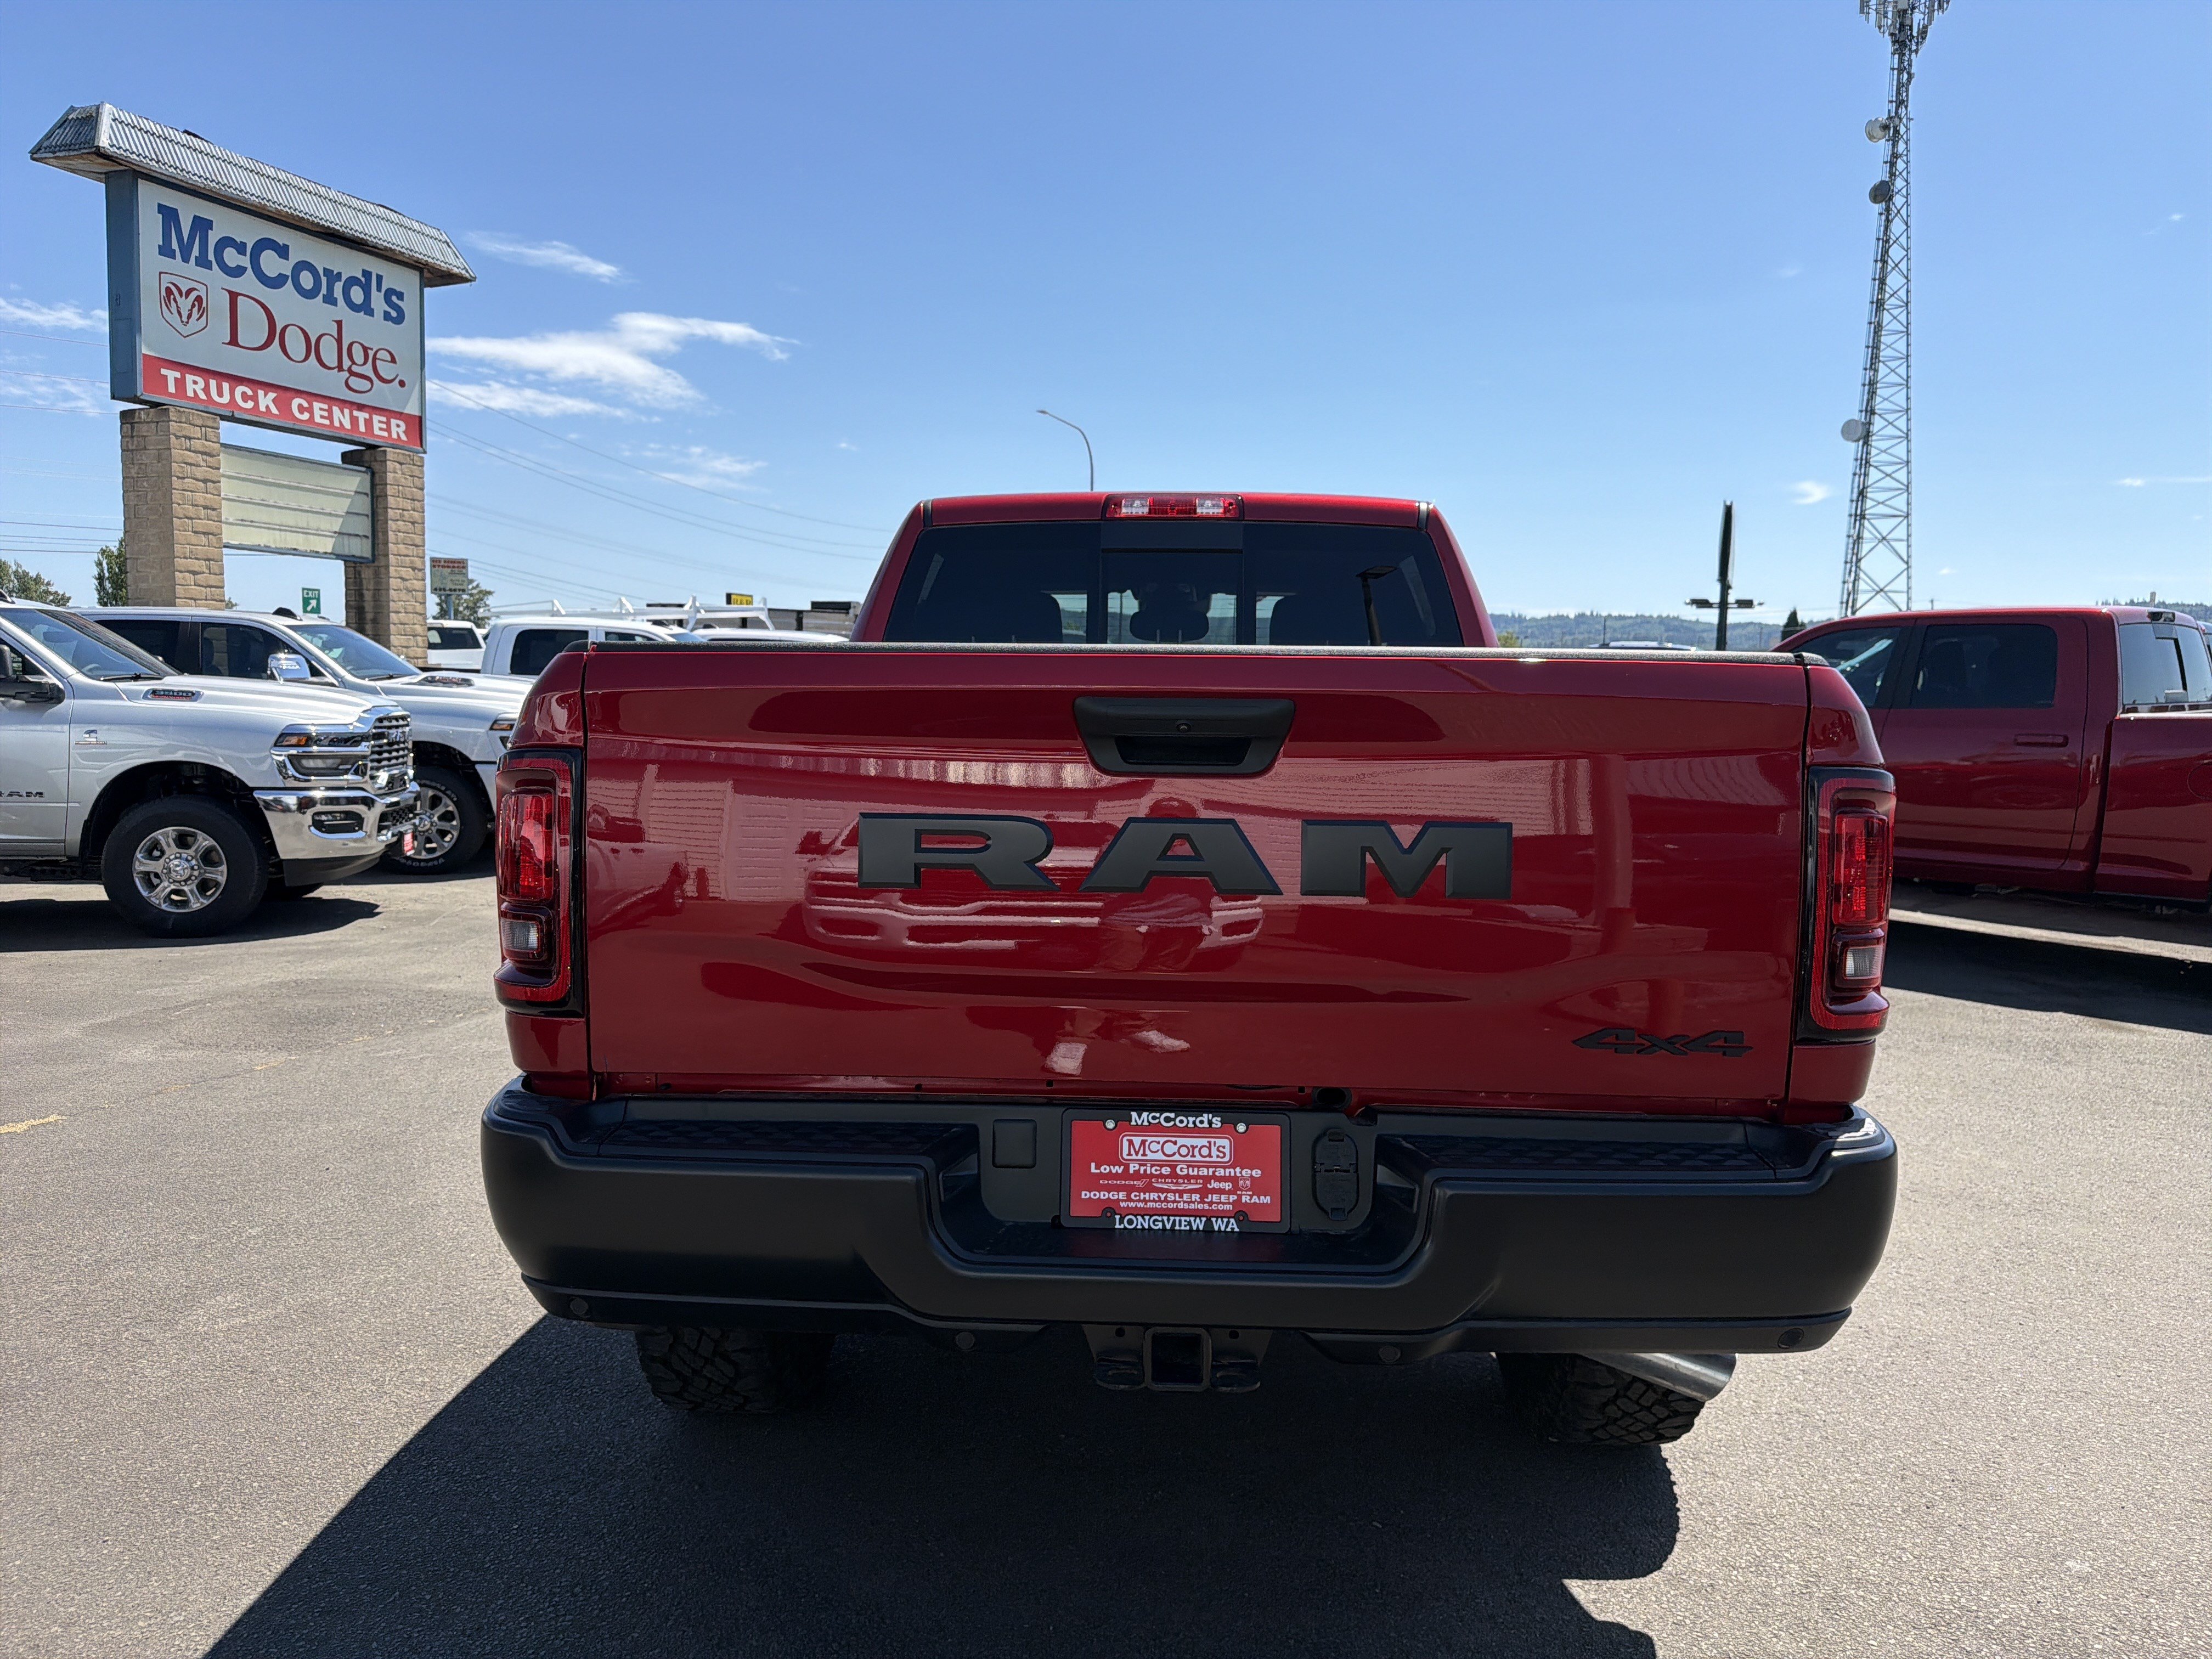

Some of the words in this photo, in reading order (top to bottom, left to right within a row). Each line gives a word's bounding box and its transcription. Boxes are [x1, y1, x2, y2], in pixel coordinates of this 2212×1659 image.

[157, 202, 405, 325] McCord's
[221, 287, 406, 394] Dodge.
[160, 368, 280, 415] TRUCK
[291, 397, 408, 442] CENTER
[303, 590, 319, 598] EXIT
[858, 812, 1513, 899] RAM
[1571, 1028, 1754, 1058] 4x4
[1130, 1111, 1222, 1128] McCord's
[1126, 1138, 1227, 1159] McCord's
[1091, 1162, 1124, 1173] Low
[1129, 1163, 1171, 1175] Price
[1176, 1164, 1262, 1177] Guarantee
[1207, 1179, 1233, 1191] Jeep
[1081, 1190, 1127, 1200] DODGE
[1131, 1192, 1201, 1202] CHRYSLER
[1204, 1194, 1238, 1203] JEEP
[1242, 1195, 1271, 1204] RAM
[1119, 1201, 1233, 1211] www.mccordsales.com
[1114, 1215, 1207, 1231] LONGVIEW
[1211, 1217, 1240, 1232] WA
